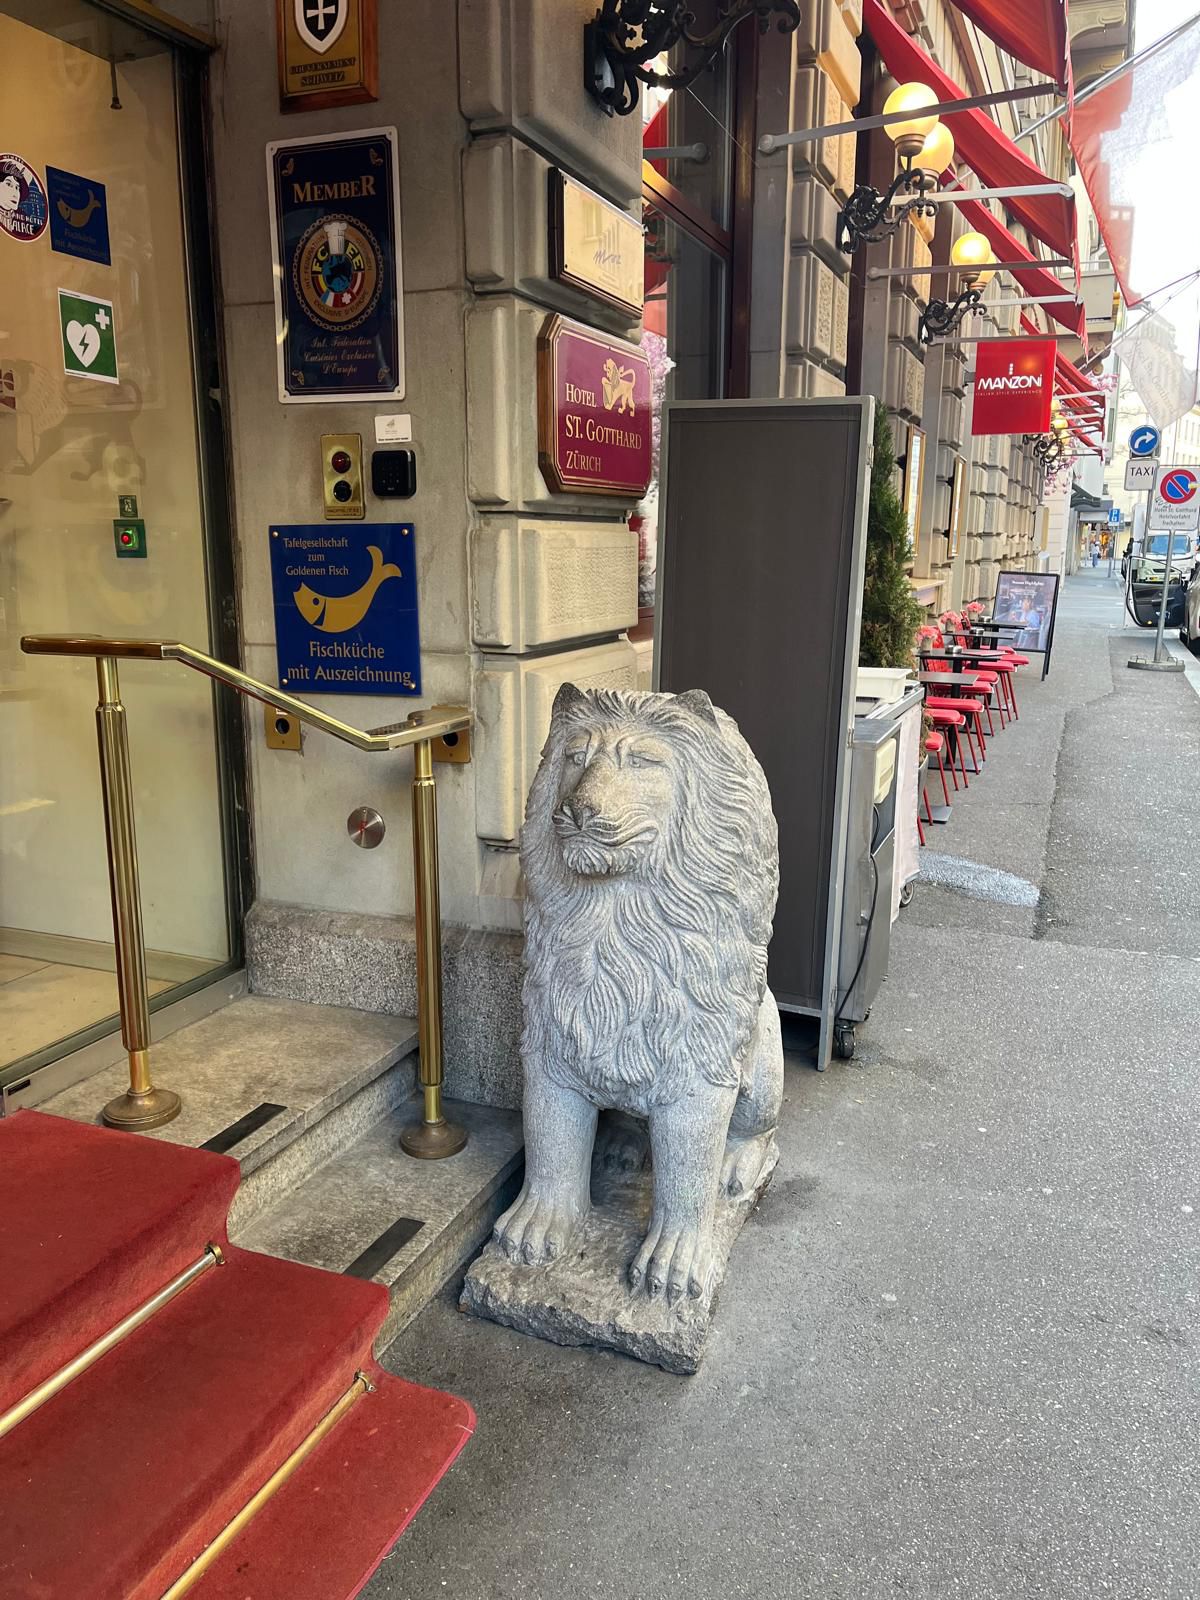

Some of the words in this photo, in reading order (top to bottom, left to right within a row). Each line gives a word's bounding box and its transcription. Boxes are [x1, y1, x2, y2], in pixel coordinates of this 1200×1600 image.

[301, 71, 345, 87] SCHWEIZ
[292, 175, 377, 204] MEMBER
[565, 382, 597, 408] HOTEL
[565, 414, 584, 439] ST.
[586, 419, 642, 450] GOTTHARD
[566, 450, 601, 473] ZÜRICH
[1130, 466, 1154, 477] TAXI
[282, 537, 349, 549] Tafelgesellschaft
[307, 553, 325, 562] zum
[286, 566, 326, 576] Goldenen
[328, 565, 349, 576] Fisch
[309, 640, 385, 659] Fischküche
[287, 664, 310, 680] mit
[314, 664, 412, 686] Auszeichnung
